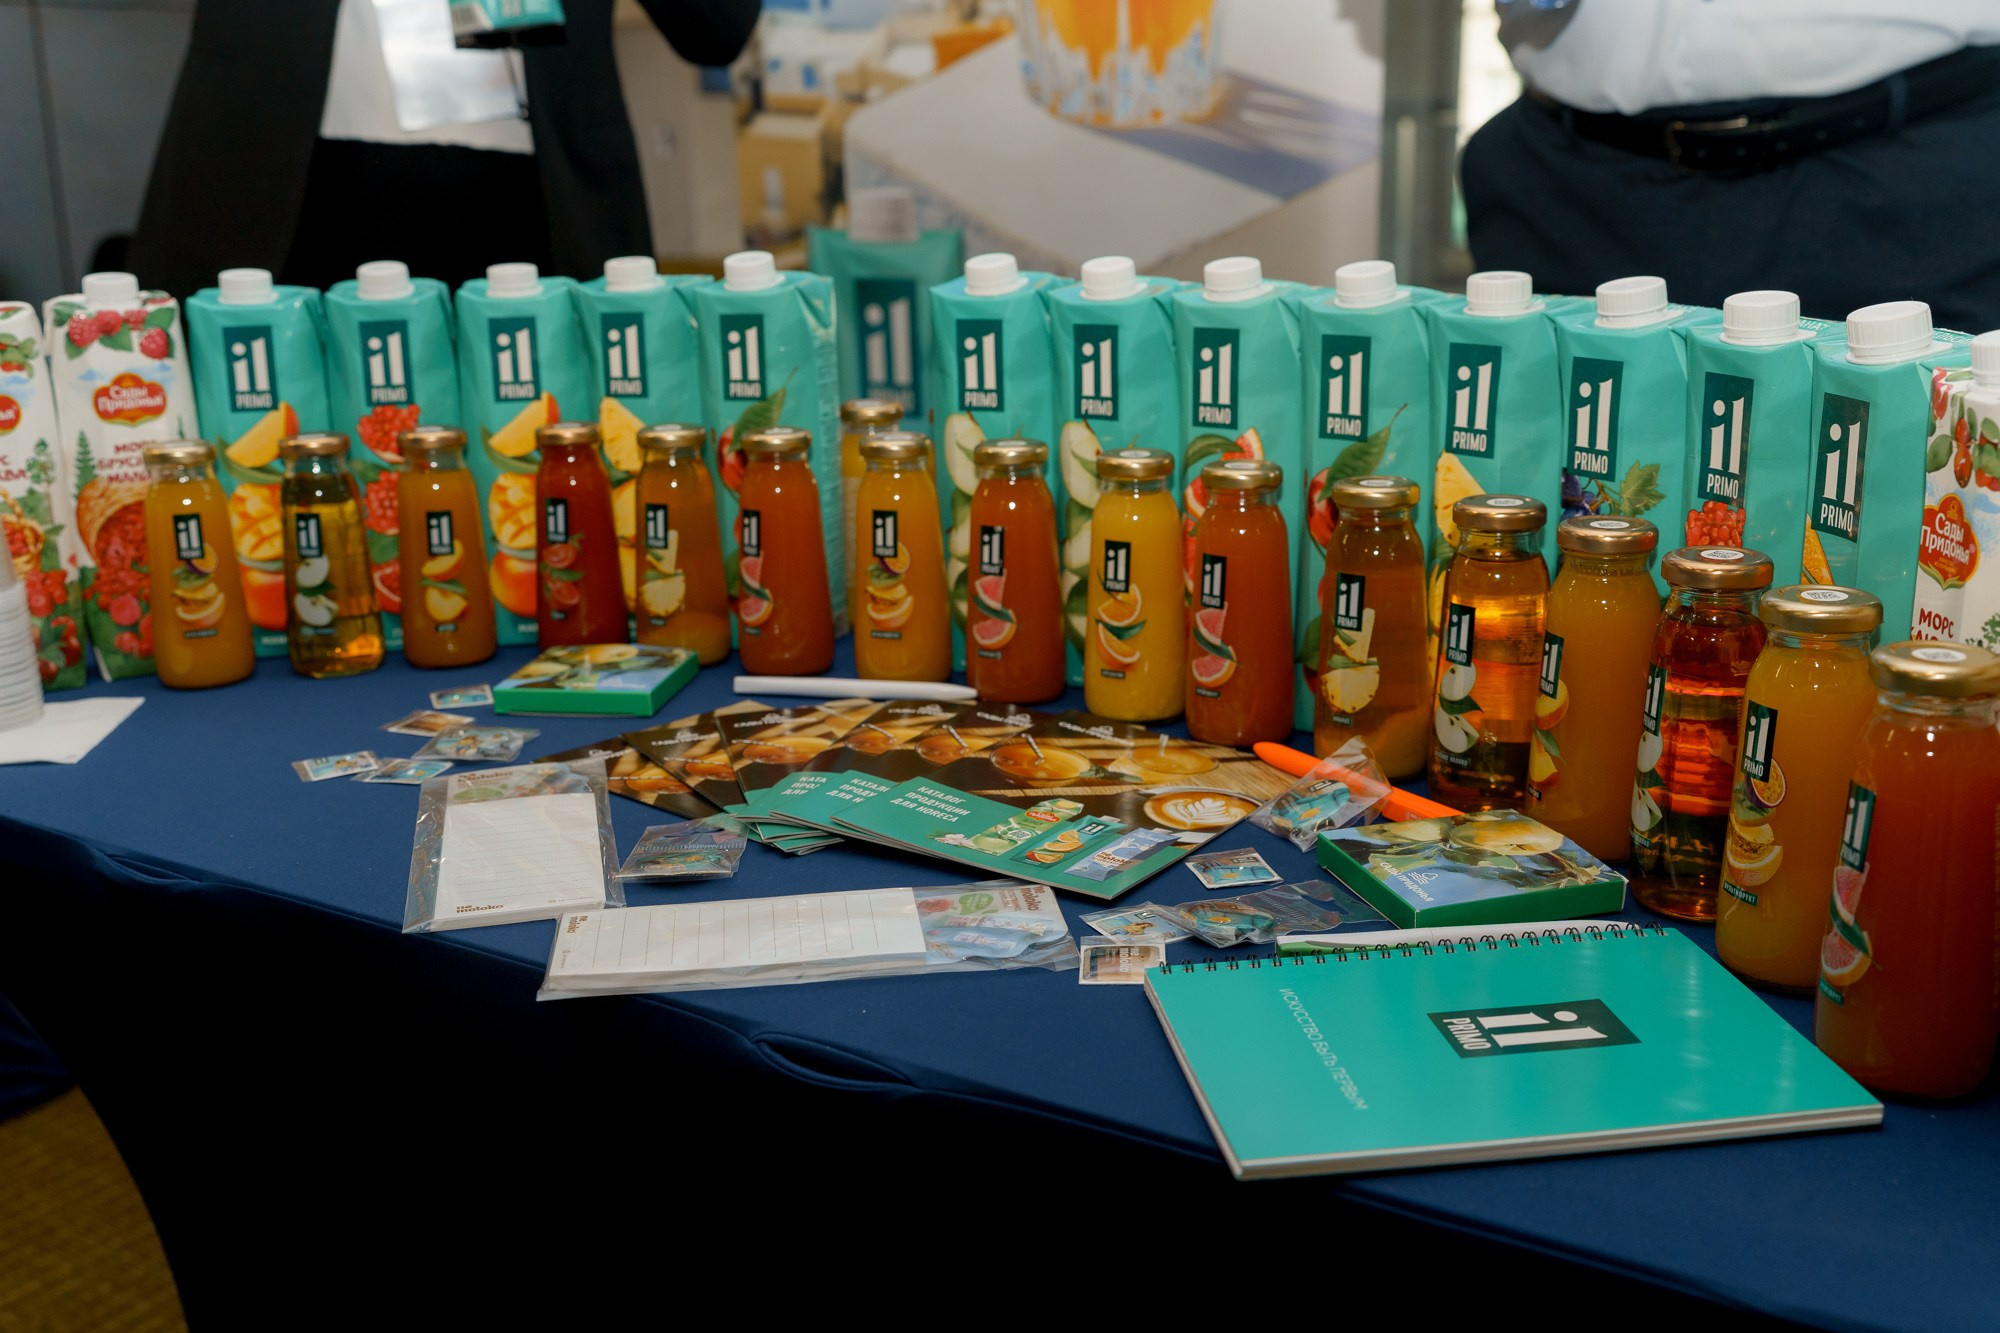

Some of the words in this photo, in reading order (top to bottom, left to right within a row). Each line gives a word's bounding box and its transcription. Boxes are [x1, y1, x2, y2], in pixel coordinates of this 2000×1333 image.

[371, 386, 408, 404] PRIMO
[499, 382, 536, 400] PRIMO
[609, 379, 643, 396] PRIMO
[728, 381, 762, 398] PRIMO
[235, 392, 274, 410] PRIMO
[964, 391, 998, 409] PRIMO
[1080, 397, 1114, 417] PRIMO
[1198, 405, 1232, 425] PRIMO
[1326, 416, 1362, 438] PRIMO
[1452, 430, 1488, 453] PRIMO
[1573, 450, 1609, 476] PRIMO
[1706, 472, 1740, 501] PRIMO
[1819, 502, 1855, 534] PRIMO
[1934, 512, 1964, 543] Сады
[1920, 525, 1970, 566] Придонья
[1105, 579, 1127, 592] PRIMO
[1201, 595, 1222, 608] PRIMO
[1336, 614, 1359, 630] PRIMO
[1918, 607, 1955, 640] МОРС
[1446, 647, 1468, 664] PRIMO
[1539, 677, 1555, 697] PRIMO
[1642, 714, 1657, 732] PRIMO
[1742, 756, 1765, 779] PRIMO
[904, 791, 971, 817] ПРОДУКЦИИ
[916, 785, 966, 805] КАТАЛОГ
[890, 797, 915, 810] ДЛЯ
[915, 804, 960, 823] HORECA
[1839, 842, 1862, 868] PRIMO
[1380, 862, 1402, 876] САДЫ
[456, 904, 504, 914] moloko
[1442, 1017, 1492, 1051] PRIMO
[1279, 987, 1324, 1041] ИСКУССТВО
[1312, 1040, 1338, 1067] БЫТЬ
[1329, 1066, 1369, 1112] ПЕРВЫМ
